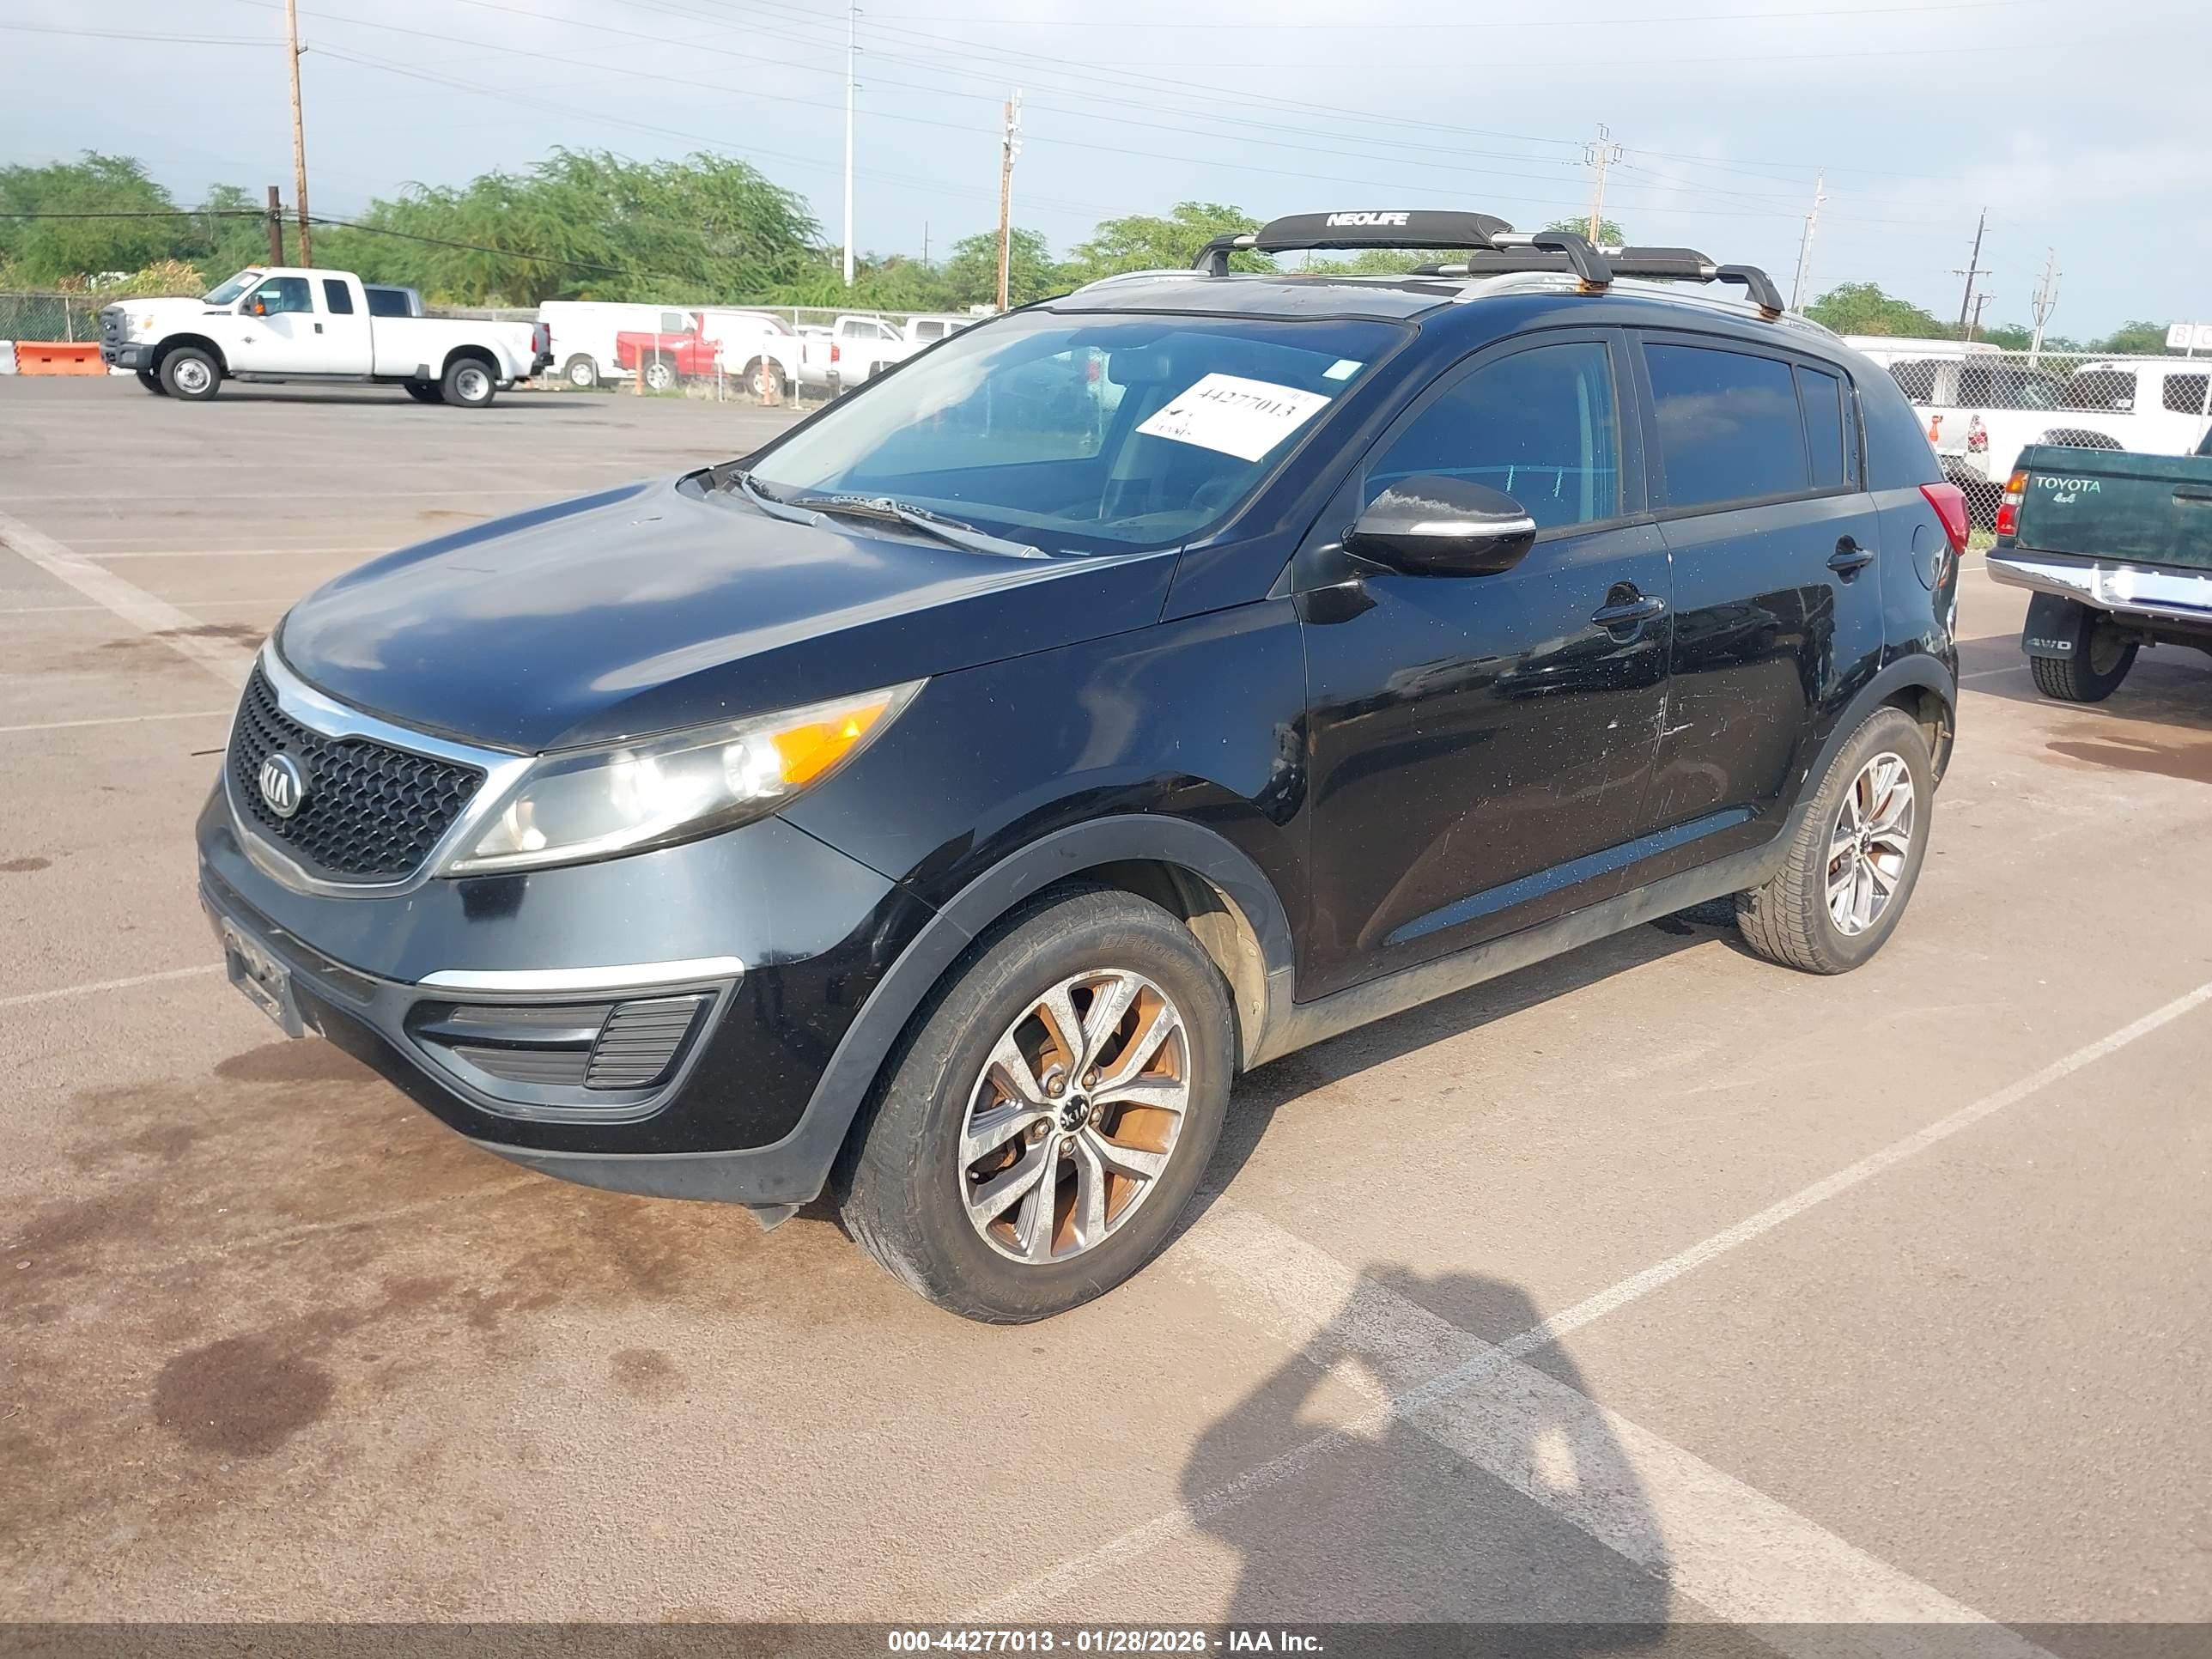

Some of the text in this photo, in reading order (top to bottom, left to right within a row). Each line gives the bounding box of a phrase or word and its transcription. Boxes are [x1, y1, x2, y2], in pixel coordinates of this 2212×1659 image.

[1326, 212, 1411, 227] NEOLIFE
[1197, 388, 1297, 417] 44277013
[2035, 476, 2101, 494] TOYOTA
[262, 762, 289, 807] KIA
